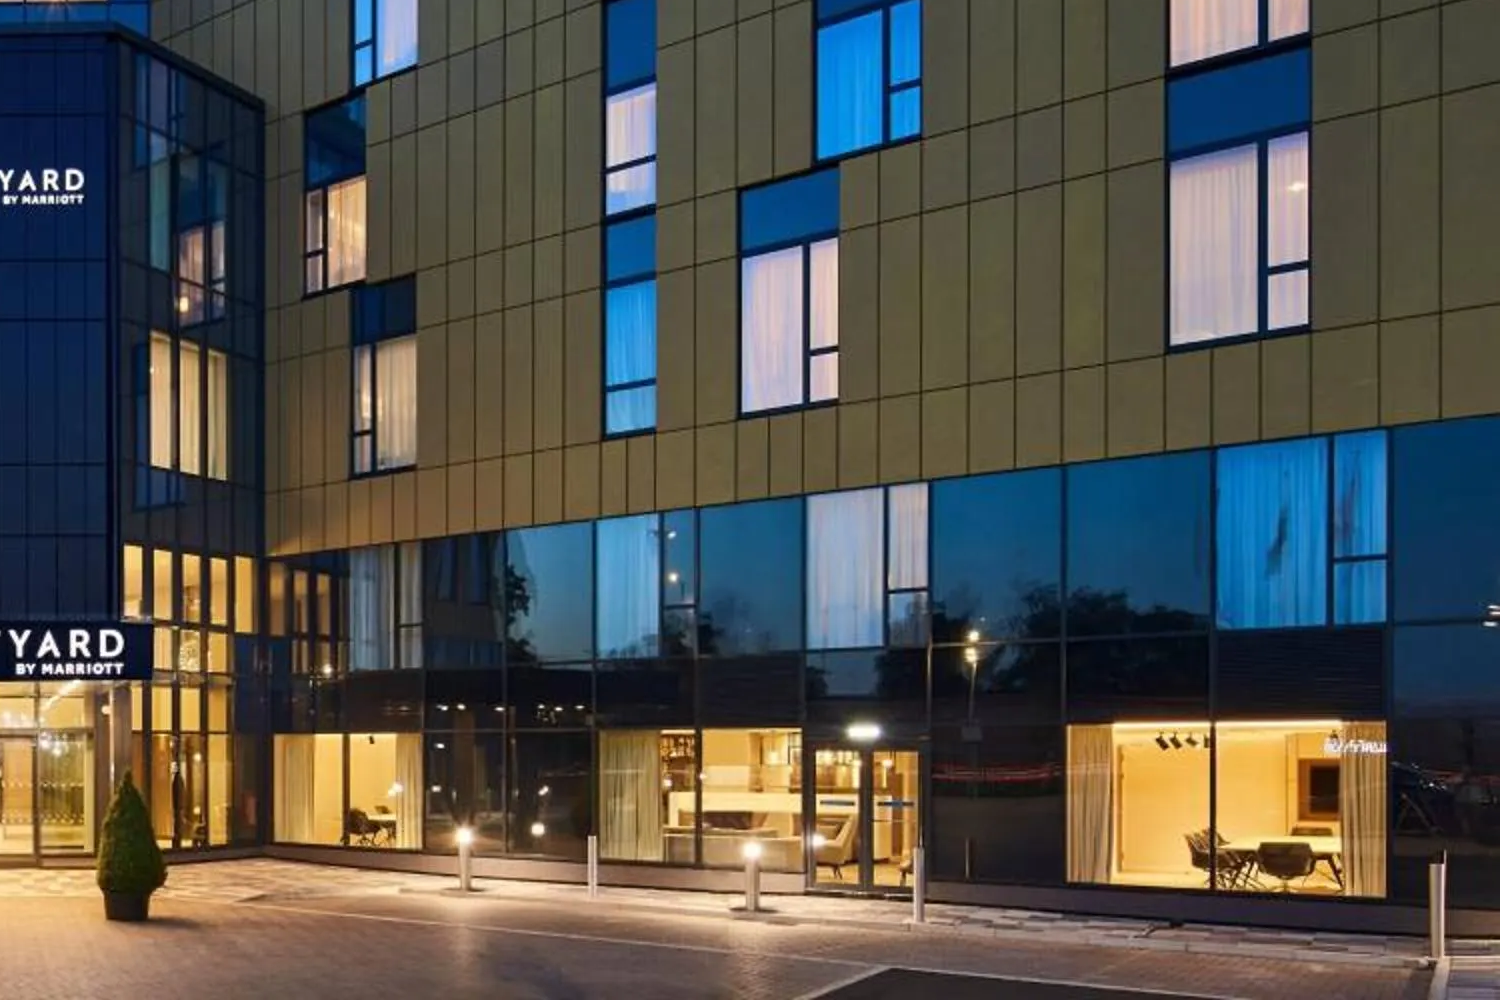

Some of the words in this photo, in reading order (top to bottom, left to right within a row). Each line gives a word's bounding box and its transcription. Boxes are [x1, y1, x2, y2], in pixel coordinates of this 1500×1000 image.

[2, 194, 18, 206] BY
[21, 194, 85, 206] MARRIOTT
[15, 663, 37, 676] BY
[41, 662, 125, 676] MARRIOTT
